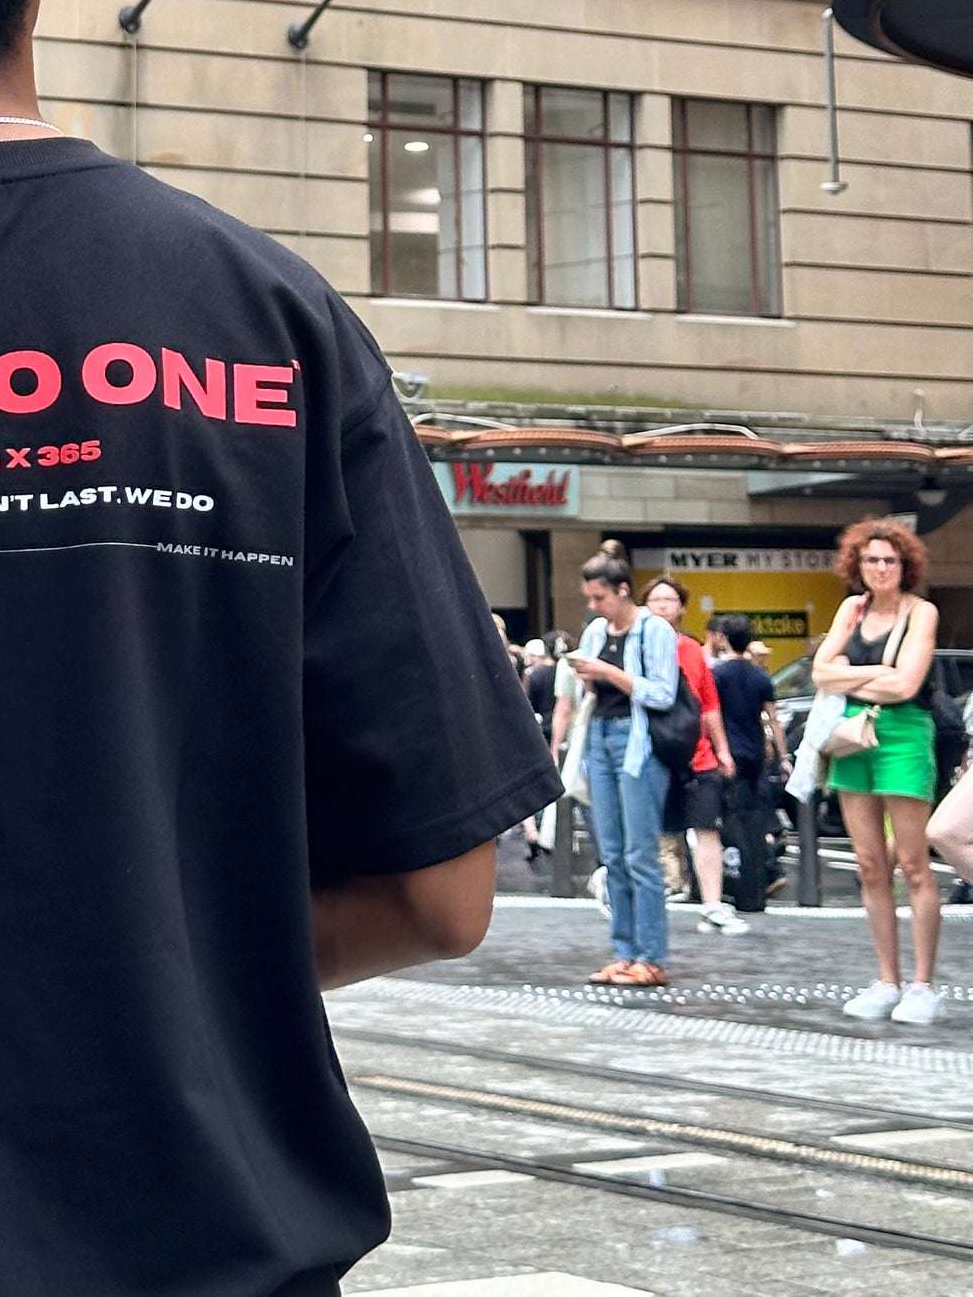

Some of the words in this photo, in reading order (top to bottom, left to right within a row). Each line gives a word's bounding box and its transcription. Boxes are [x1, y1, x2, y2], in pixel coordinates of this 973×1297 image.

[81, 341, 297, 428] ONE
[6, 447, 32, 469] X
[37, 439, 103, 467] 365
[451, 462, 572, 506] Westfield
[124, 486, 173, 508] WE
[176, 492, 215, 512] DO
[156, 542, 202, 556] MAKE
[203, 546, 219, 558] IT
[221, 549, 294, 567] HAPPEN
[670, 552, 740, 568] MYER
